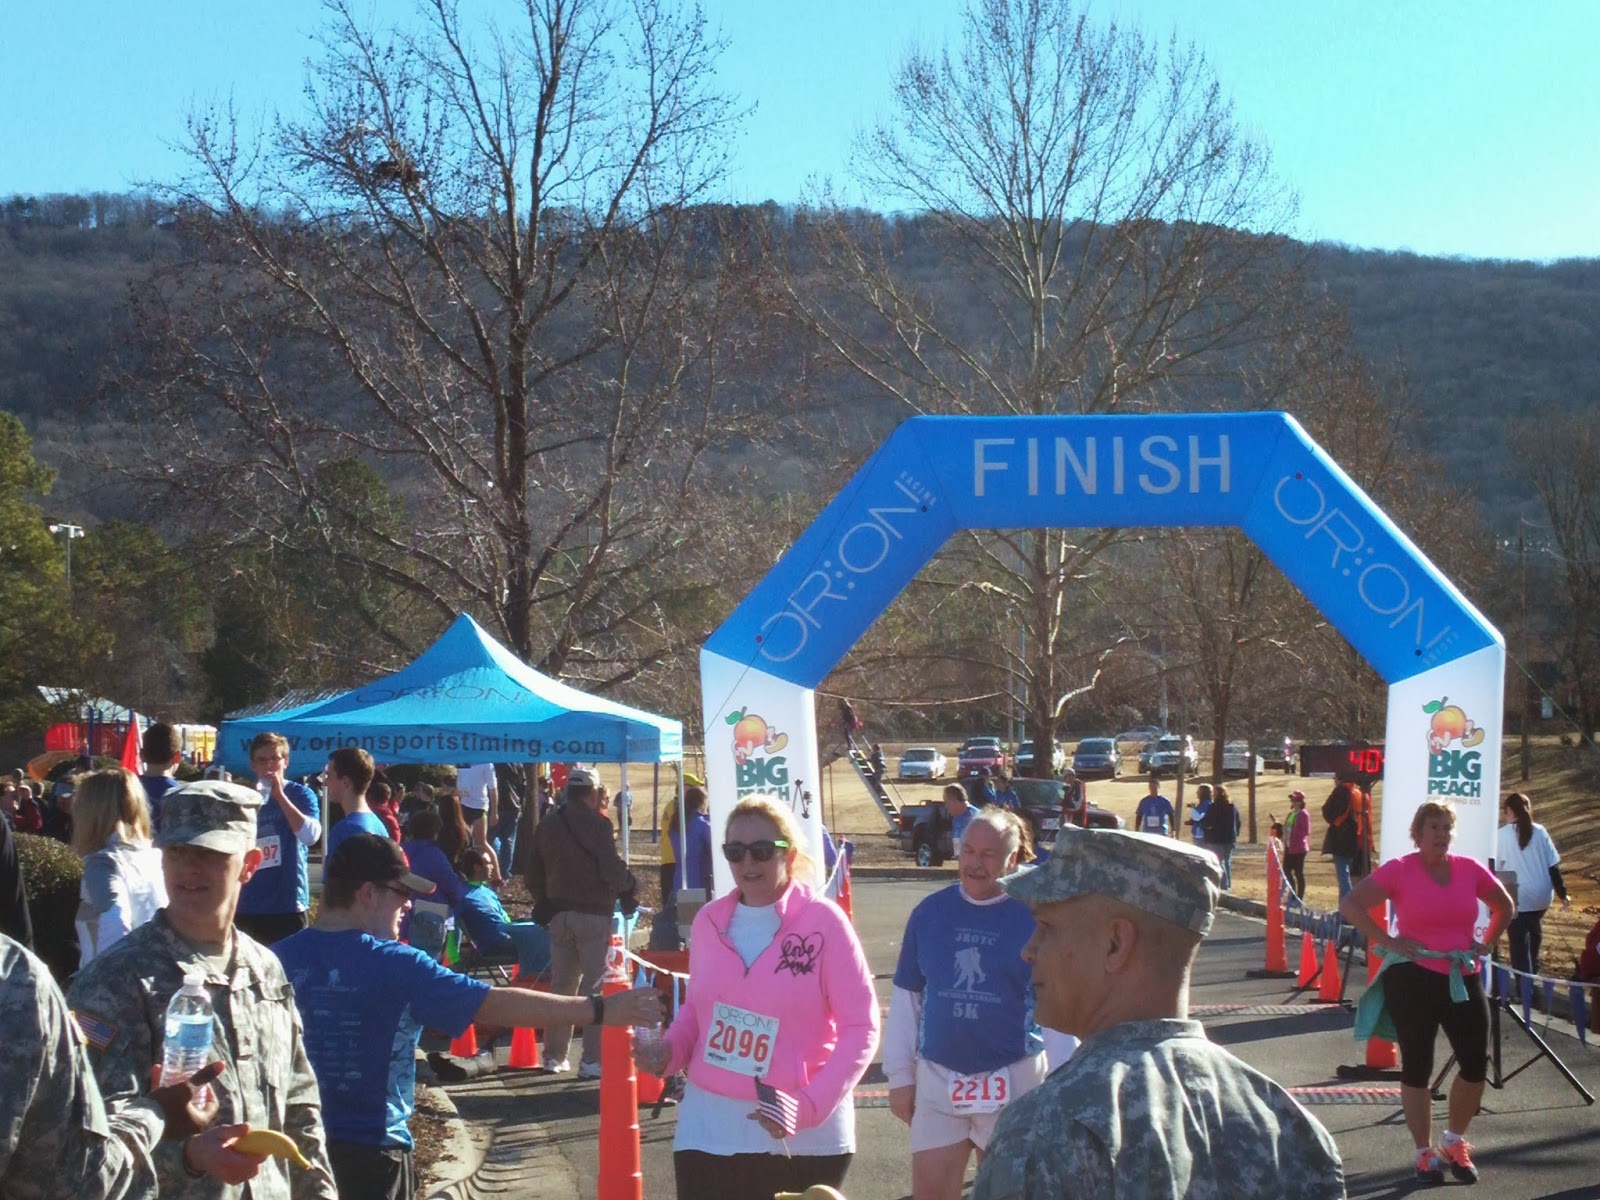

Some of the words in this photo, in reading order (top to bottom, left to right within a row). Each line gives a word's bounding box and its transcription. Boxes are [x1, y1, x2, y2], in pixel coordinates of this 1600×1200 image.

[973, 434, 1231, 497] FINISH
[239, 731, 606, 757] ww.orionsportstiming.com
[735, 756, 790, 788] BIG
[1428, 749, 1482, 781] BIG
[1427, 779, 1481, 798] PEACH
[708, 1019, 771, 1064] 2096
[951, 1076, 1007, 1102] 2213
